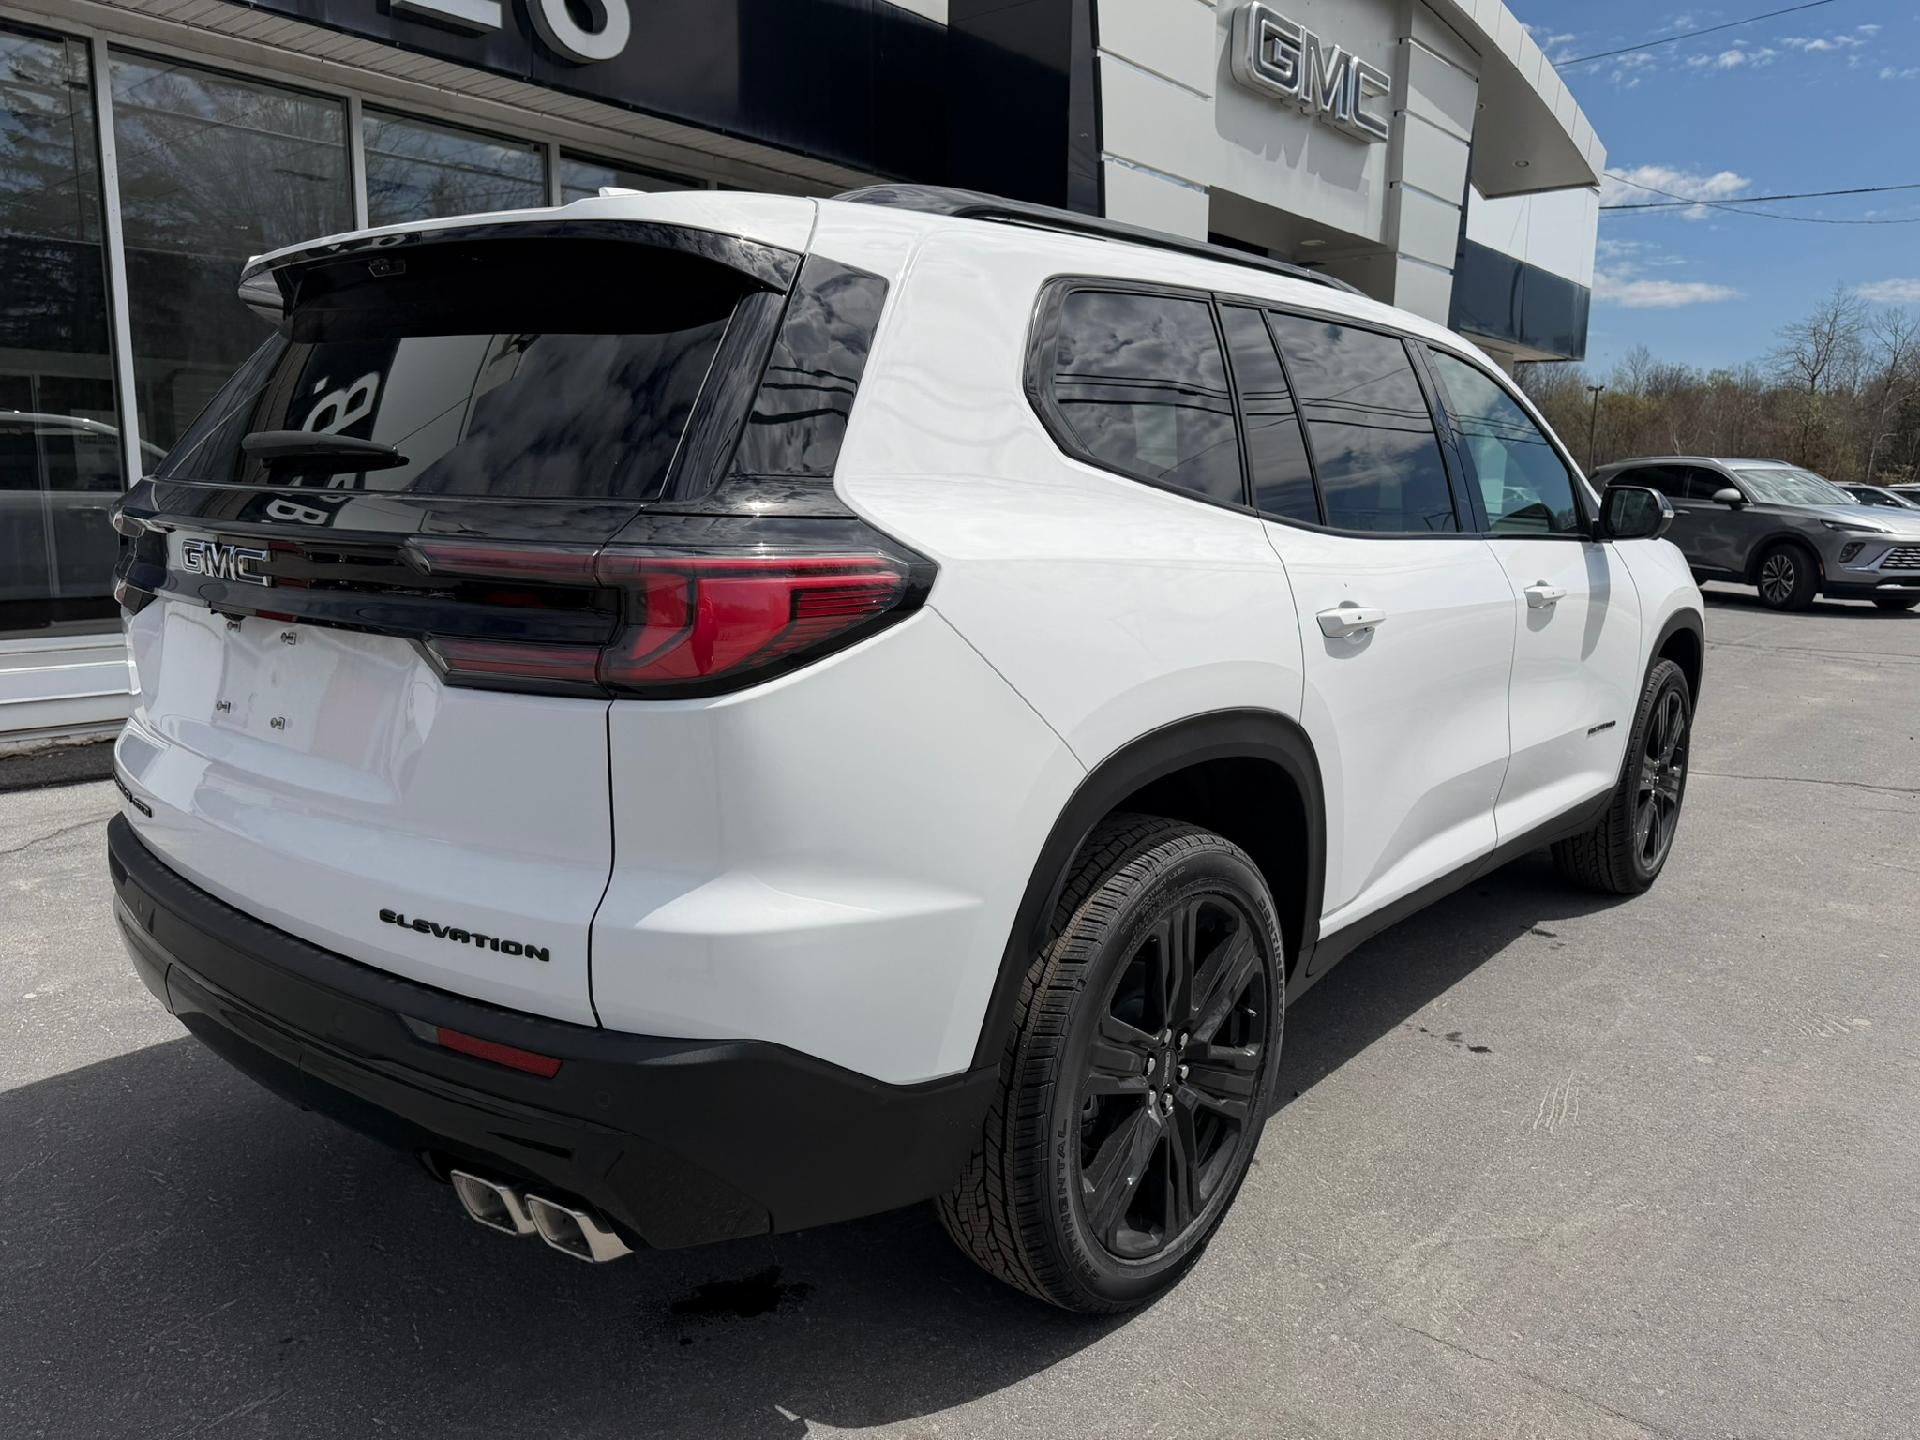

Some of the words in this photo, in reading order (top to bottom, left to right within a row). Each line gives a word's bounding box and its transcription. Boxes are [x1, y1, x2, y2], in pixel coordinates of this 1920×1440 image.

[1240, 1, 1391, 141] GMC
[181, 539, 272, 588] GMC
[379, 908, 550, 962] ELEVATION
